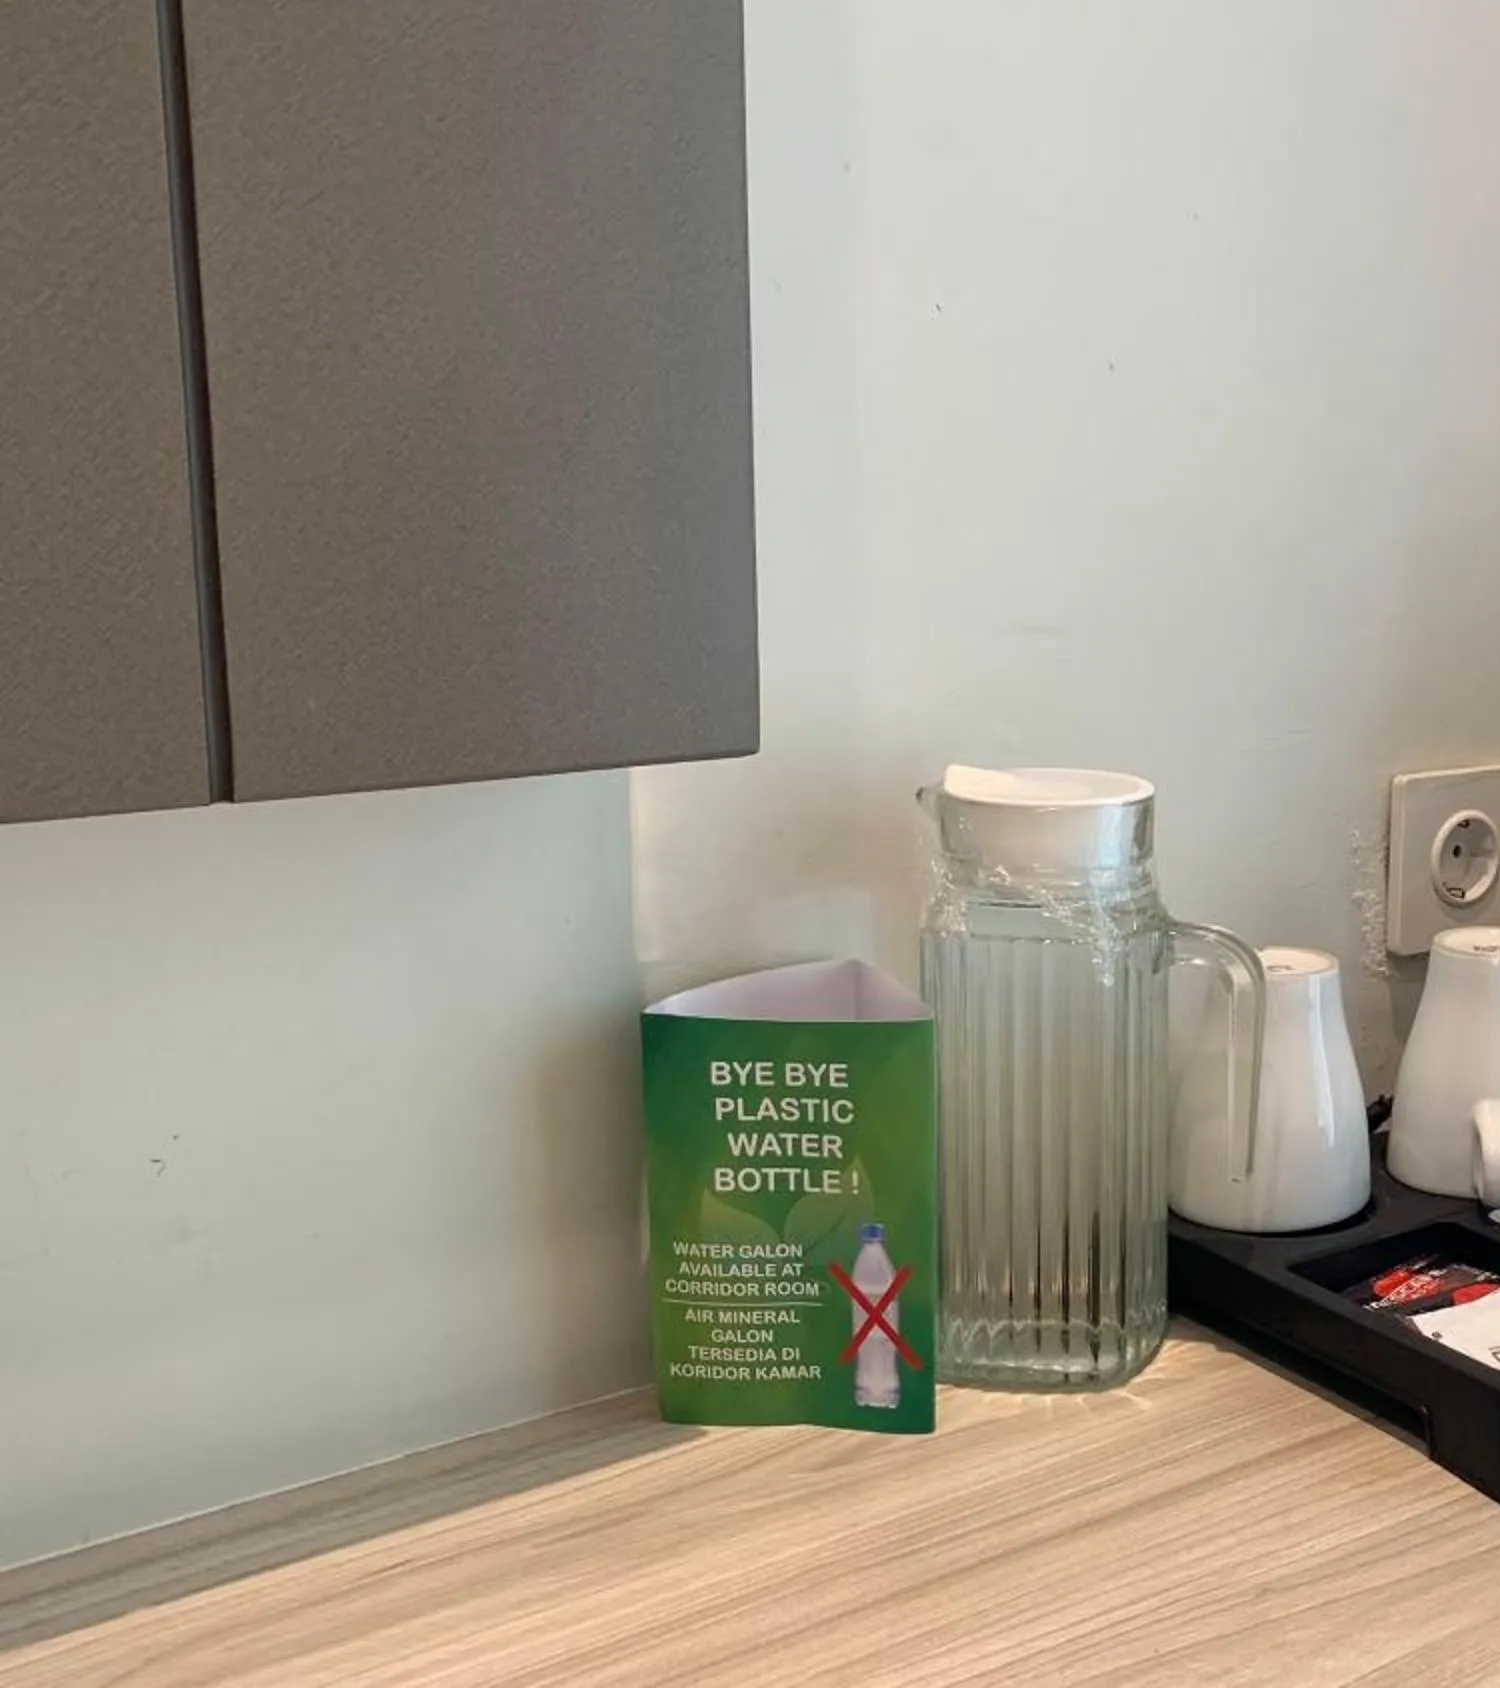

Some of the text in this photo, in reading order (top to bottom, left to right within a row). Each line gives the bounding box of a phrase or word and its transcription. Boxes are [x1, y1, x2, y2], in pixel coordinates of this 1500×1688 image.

[711, 1061, 849, 1088] BYE BYE
[715, 1097, 854, 1124] PLASTIC
[727, 1132, 843, 1159] WATER
[673, 1241, 803, 1259] WATER GALON
[679, 1261, 804, 1278] AVAILABLE AT
[665, 1278, 820, 1297] CORRIDOR ROOM
[684, 1308, 801, 1324] AIR MINERAL
[711, 1329, 774, 1344] GALON
[687, 1345, 801, 1362] TERSEDIA DI
[669, 1363, 823, 1380] KORIDOR KAMAR
